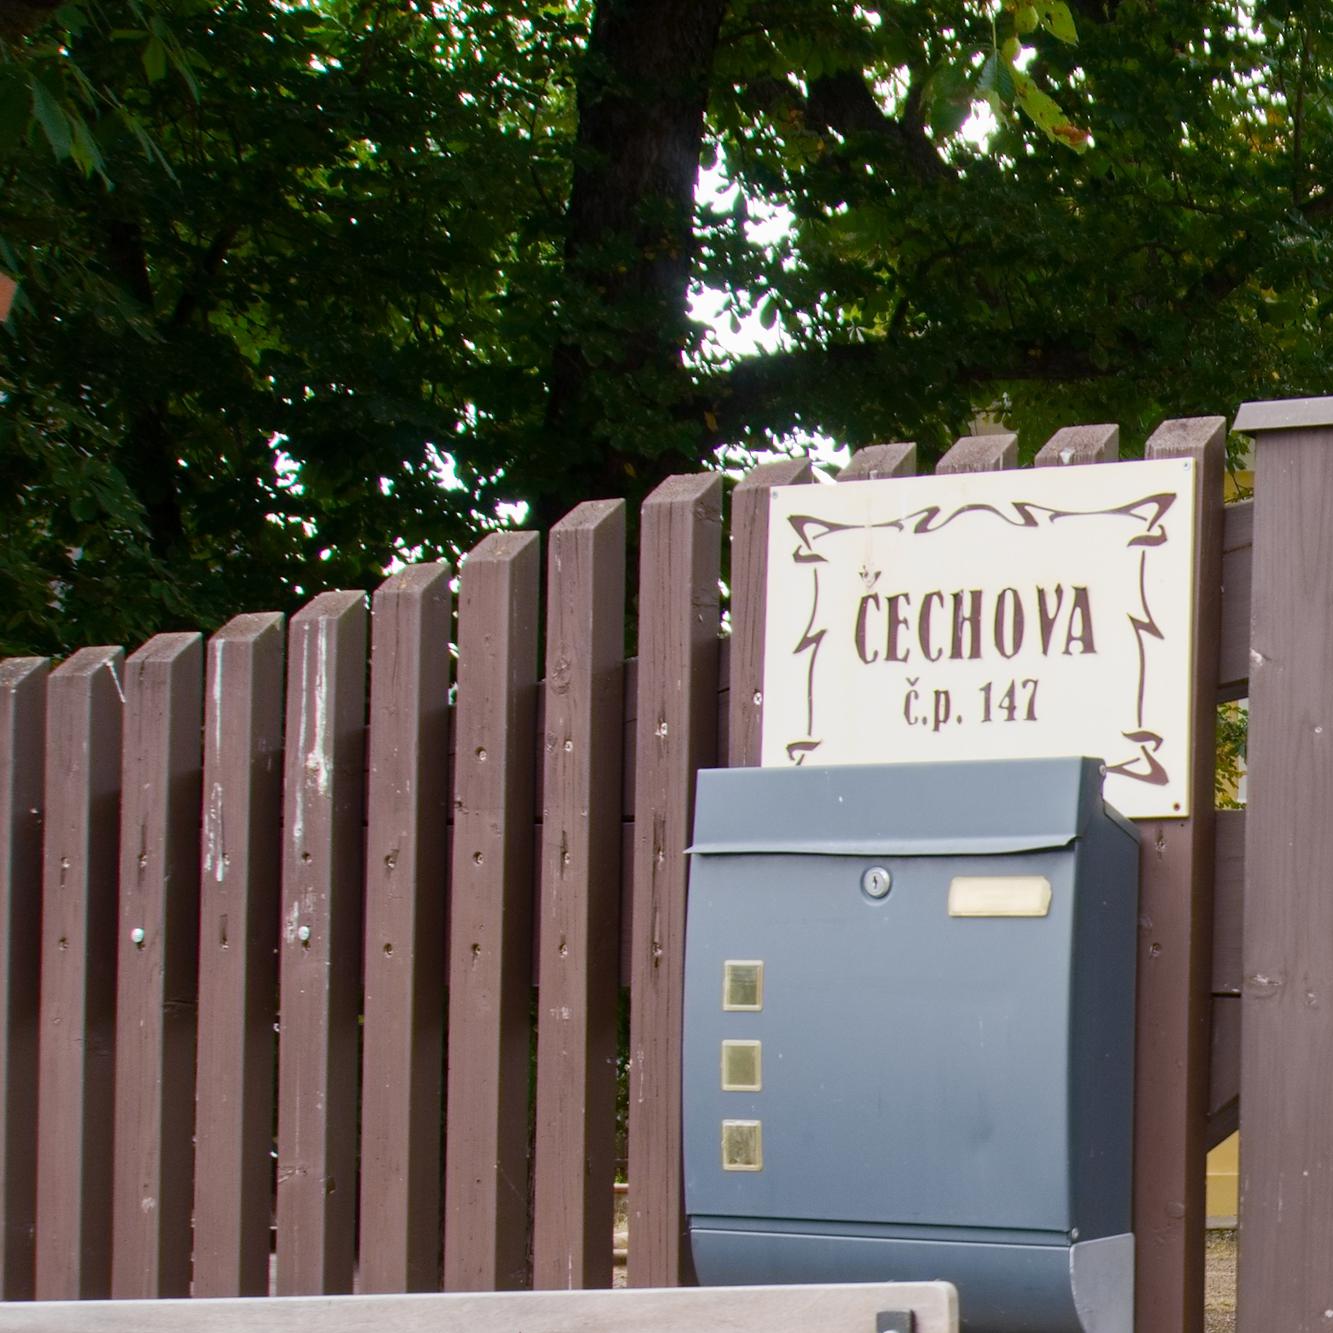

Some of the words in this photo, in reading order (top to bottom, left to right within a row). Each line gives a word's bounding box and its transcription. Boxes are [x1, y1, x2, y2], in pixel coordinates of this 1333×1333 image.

[854, 564, 1097, 665] ČECHOVA
[903, 677, 962, 732] č.p.
[979, 678, 1039, 723] 147
